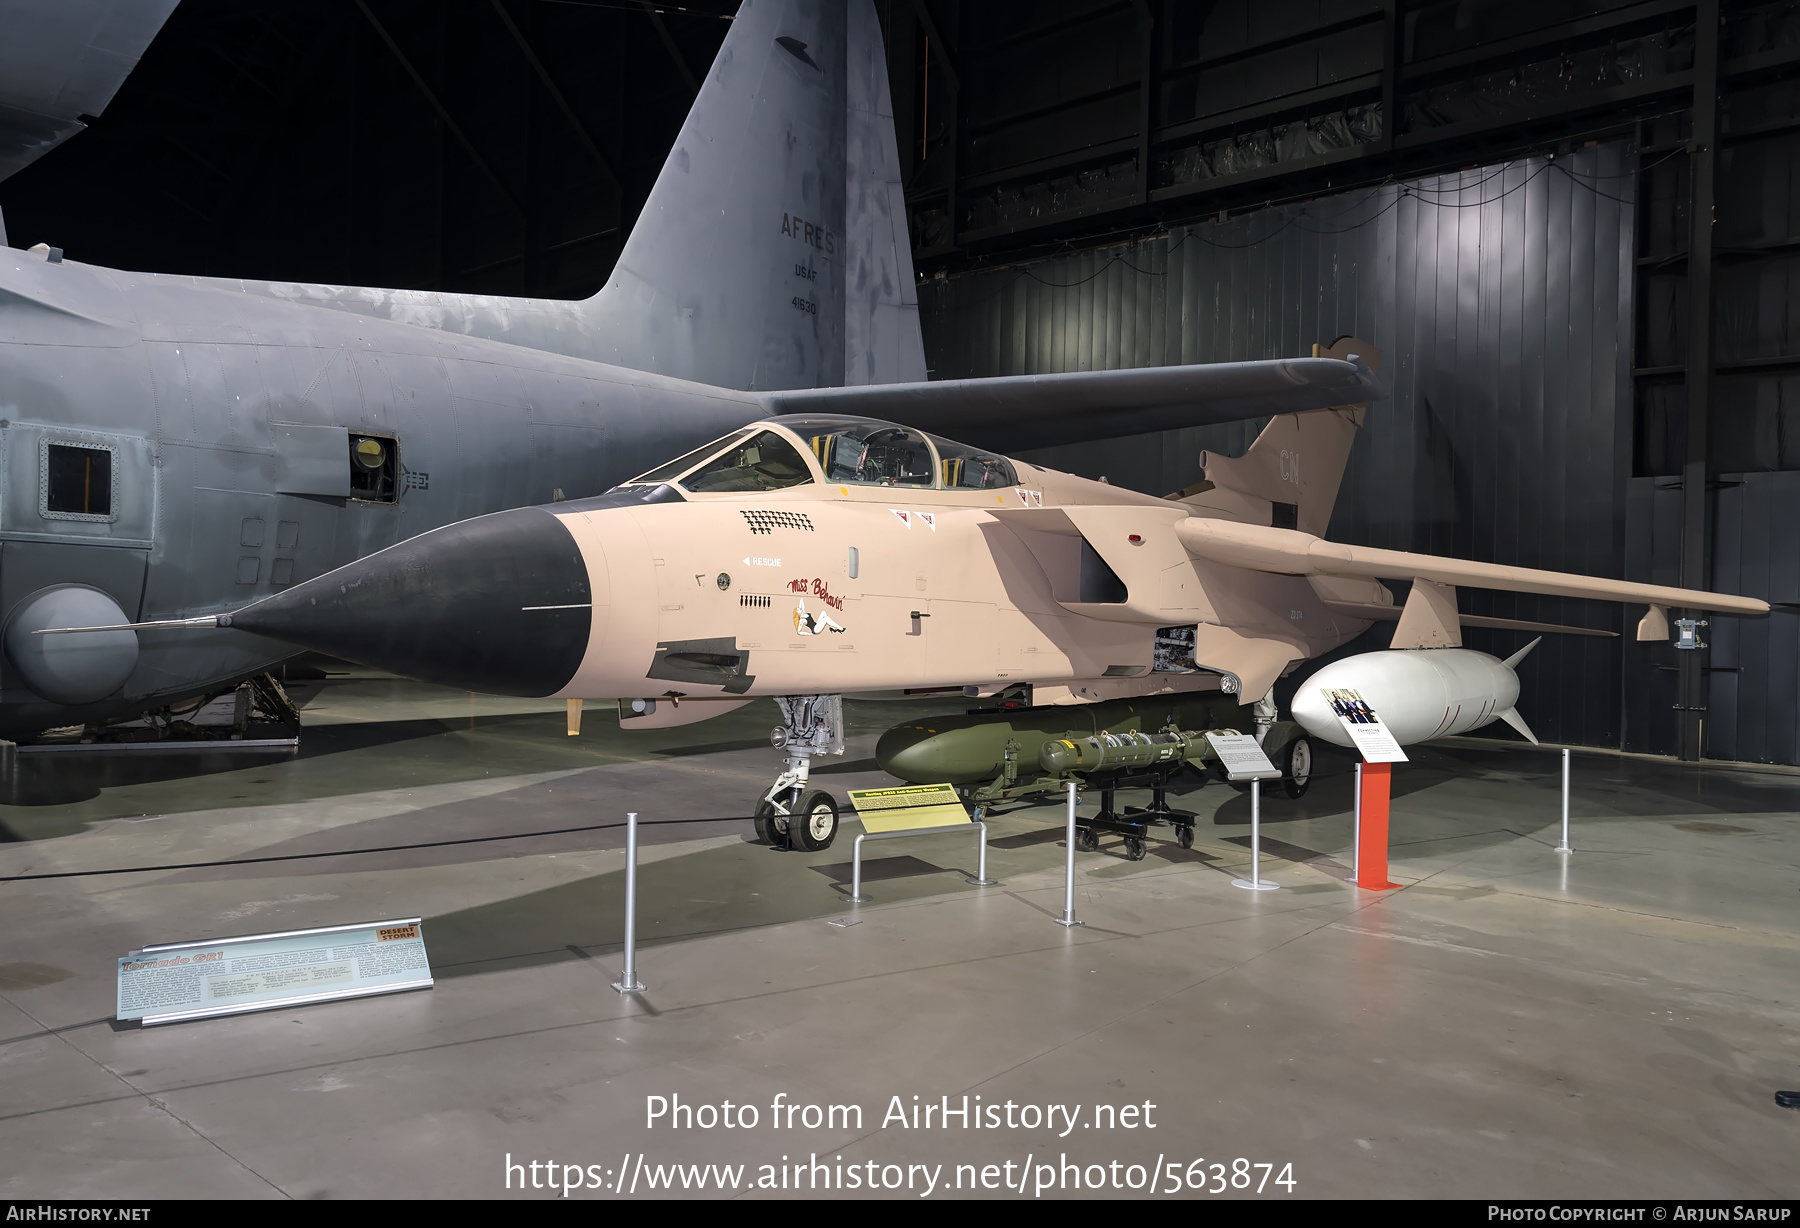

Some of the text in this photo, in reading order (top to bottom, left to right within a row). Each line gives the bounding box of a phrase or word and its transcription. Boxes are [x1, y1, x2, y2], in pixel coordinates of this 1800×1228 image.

[781, 212, 835, 255] AFRES
[795, 264, 818, 282] USAF
[792, 296, 816, 315] 41630
[1280, 450, 1299, 484] CN
[752, 556, 782, 567] RESCUE
[380, 926, 414, 936] DESERT
[382, 932, 415, 941] STORM
[122, 955, 191, 971] Tornado
[193, 951, 224, 962] GR1
